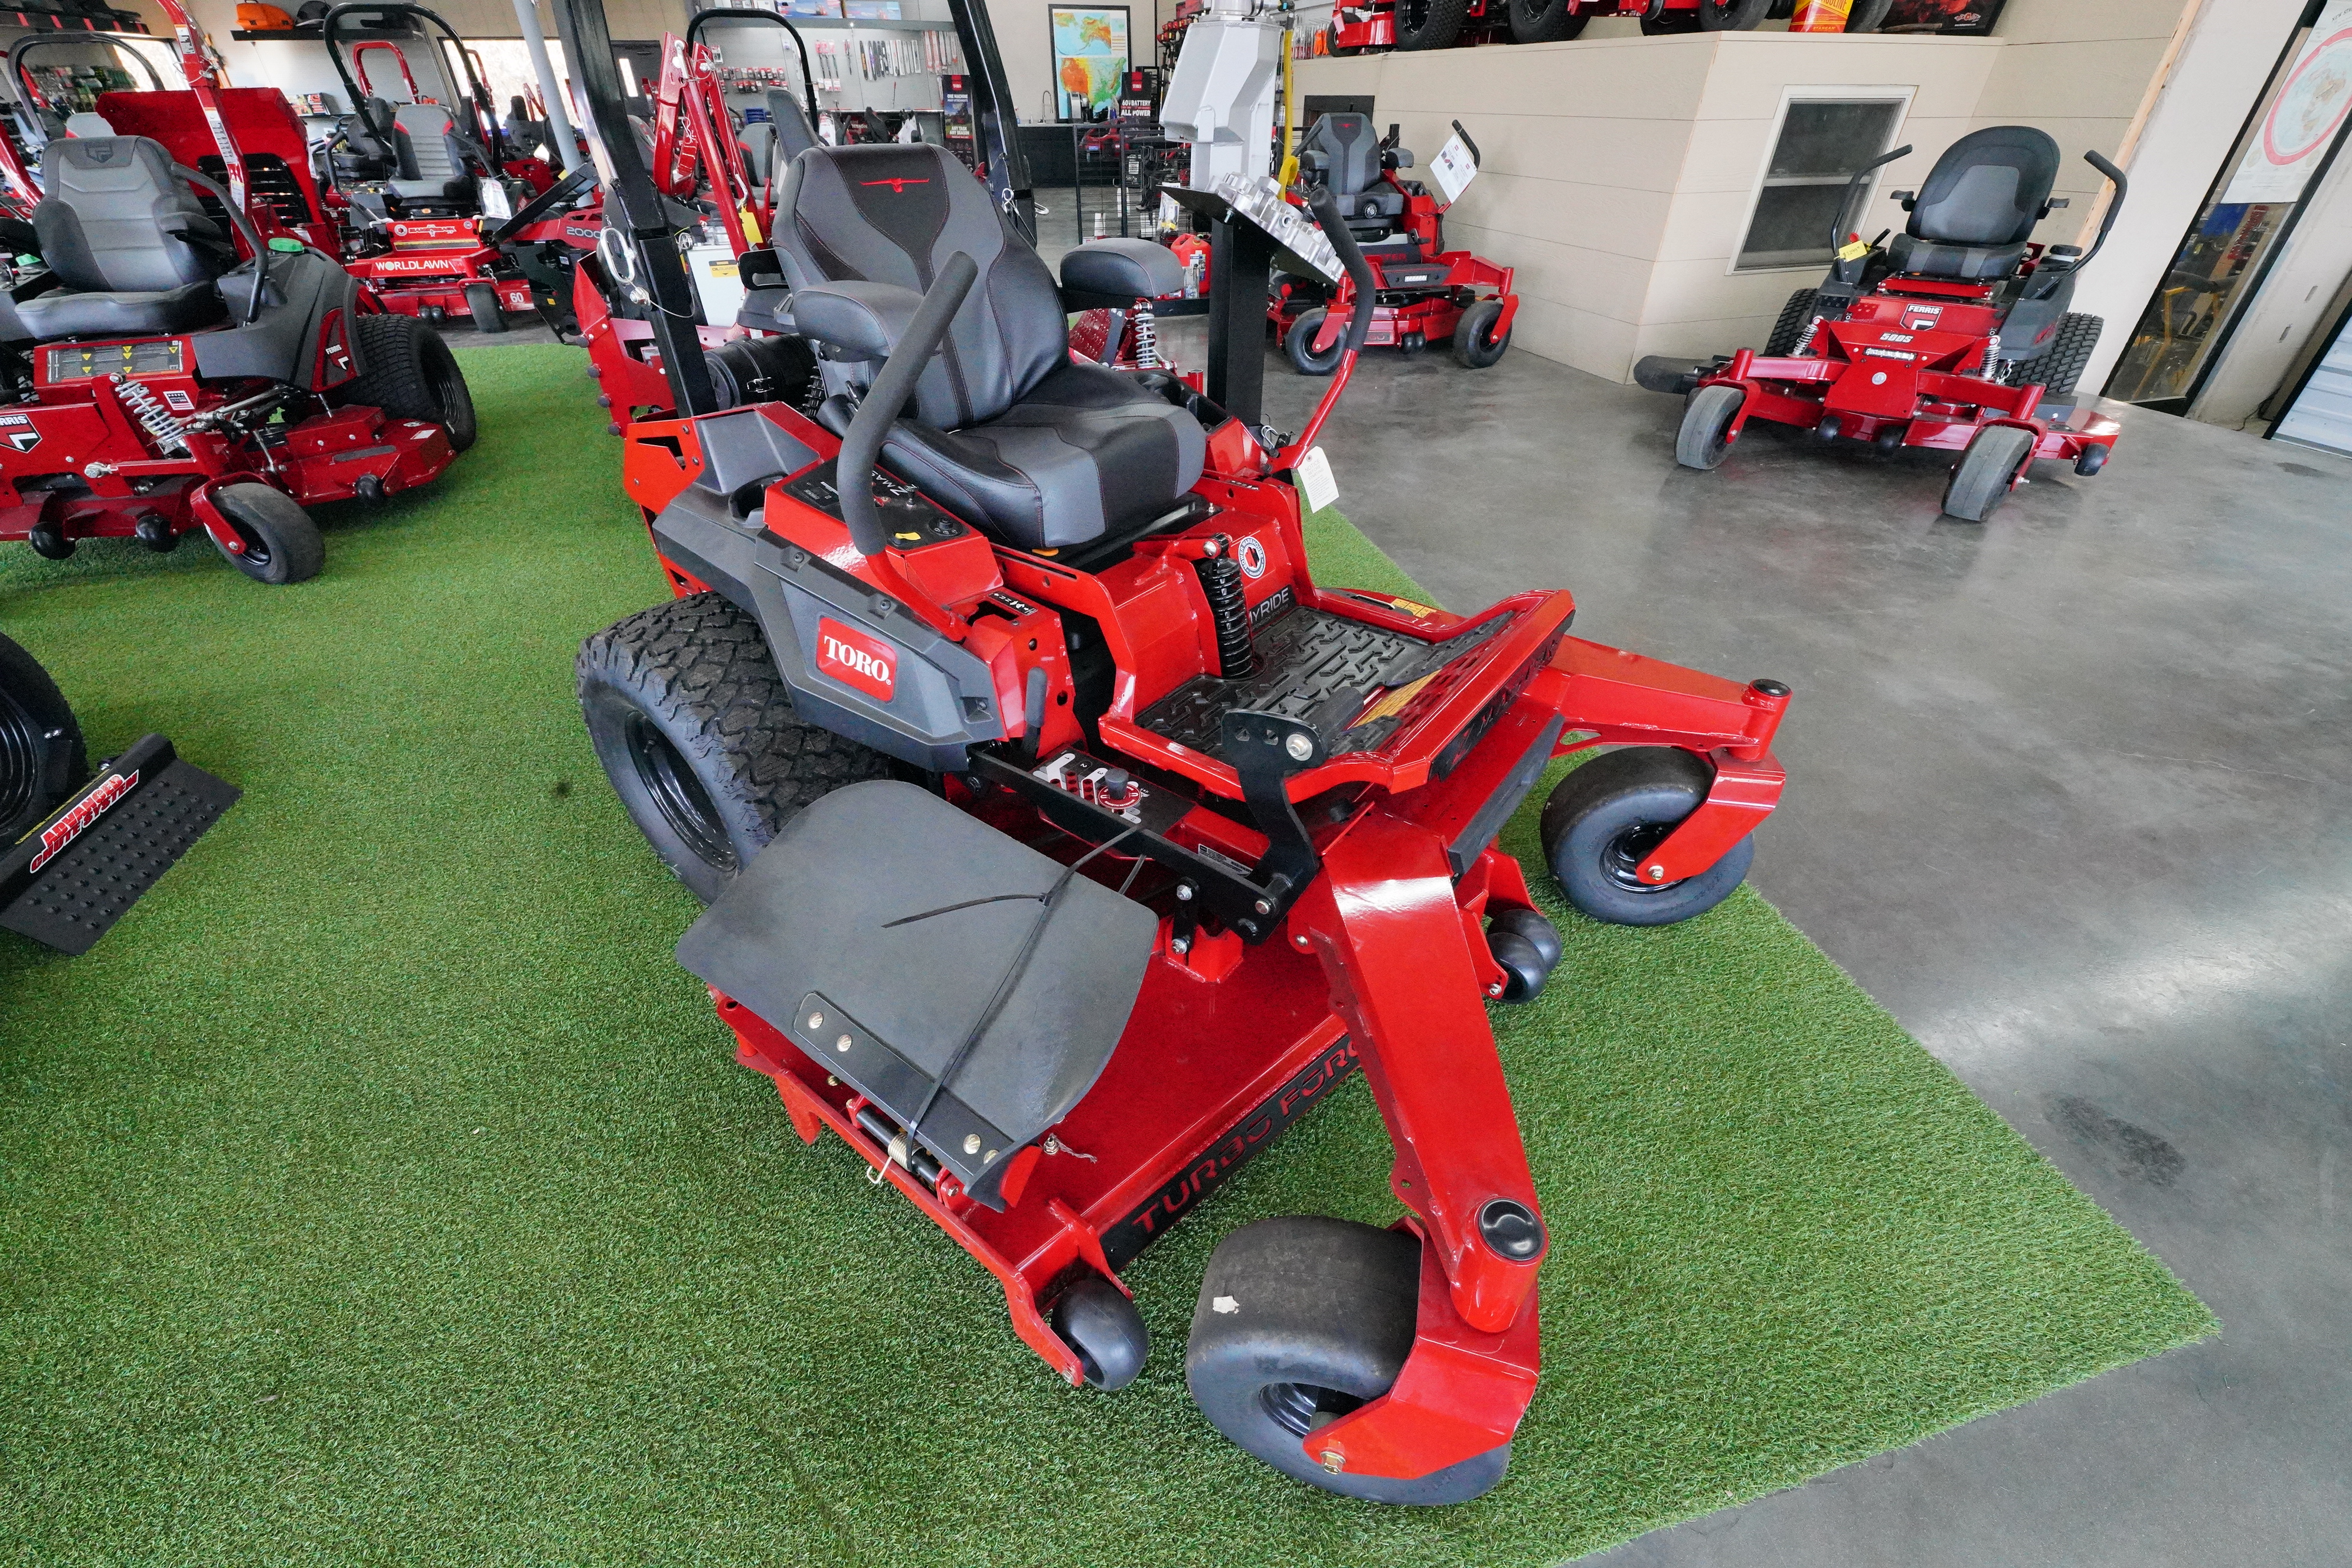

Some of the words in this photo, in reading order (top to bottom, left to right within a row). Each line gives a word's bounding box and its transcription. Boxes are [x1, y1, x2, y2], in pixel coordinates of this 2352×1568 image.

[567, 227, 601, 239] 2000
[509, 292, 525, 303] 60
[1907, 305, 1942, 315] FERRIS
[1880, 332, 1914, 343] 500S
[325, 344, 342, 355] FERRIS
[1305, 458, 1321, 472] NOTICE
[1242, 538, 1263, 558] WAREHOUSE
[41, 775, 124, 847] ADVANCED
[31, 821, 83, 873] CHUTE
[82, 770, 139, 828] SYSTEM
[1132, 1113, 1272, 1233] TURBO
